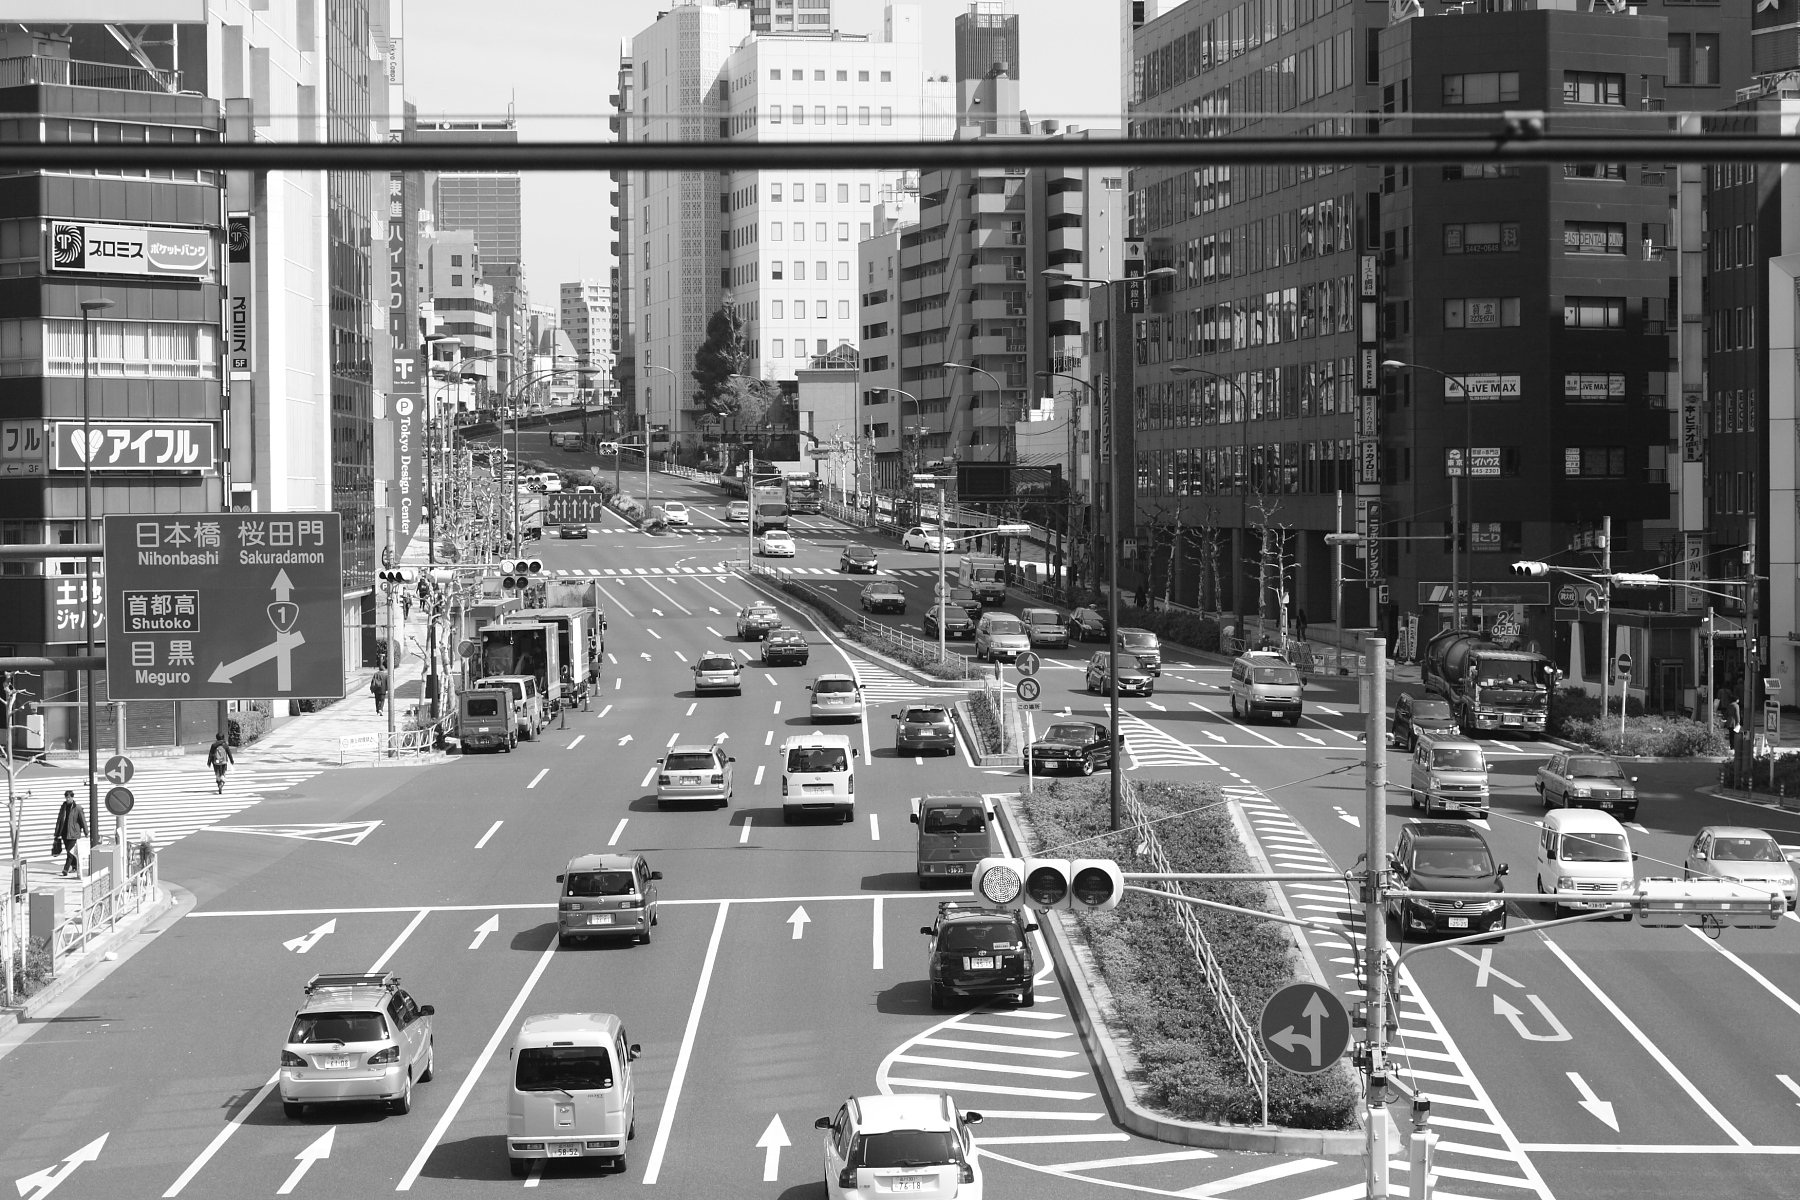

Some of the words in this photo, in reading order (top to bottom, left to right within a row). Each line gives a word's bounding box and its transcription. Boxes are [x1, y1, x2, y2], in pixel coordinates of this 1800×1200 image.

[89, 239, 143, 259] プロミス
[1580, 233, 1606, 245] DENTAL
[150, 242, 205, 257] ポケットバンク
[233, 297, 246, 352] プロミス
[1491, 384, 1516, 392] MAX
[6, 428, 40, 451] フル
[400, 417, 411, 452] Tokyo
[107, 429, 199, 463] アイフル
[29, 465, 39, 473] 3F
[401, 456, 411, 494] Design
[402, 498, 411, 535] Center
[136, 522, 221, 548] 日本橋
[238, 521, 323, 547] 桜田門
[138, 551, 219, 565] Nihonbashi
[240, 550, 324, 564] Sakuradamon
[1370, 519, 1379, 584] ニッポンレンタカー
[57, 579, 102, 604] 土地
[1448, 590, 1482, 598] NPPON
[128, 595, 195, 616] 首都高
[278, 607, 286, 623] 1
[132, 617, 191, 629] Shutoko
[1492, 625, 1520, 635] OPEN
[132, 641, 194, 667] 目黒
[136, 670, 190, 684] Meguro
